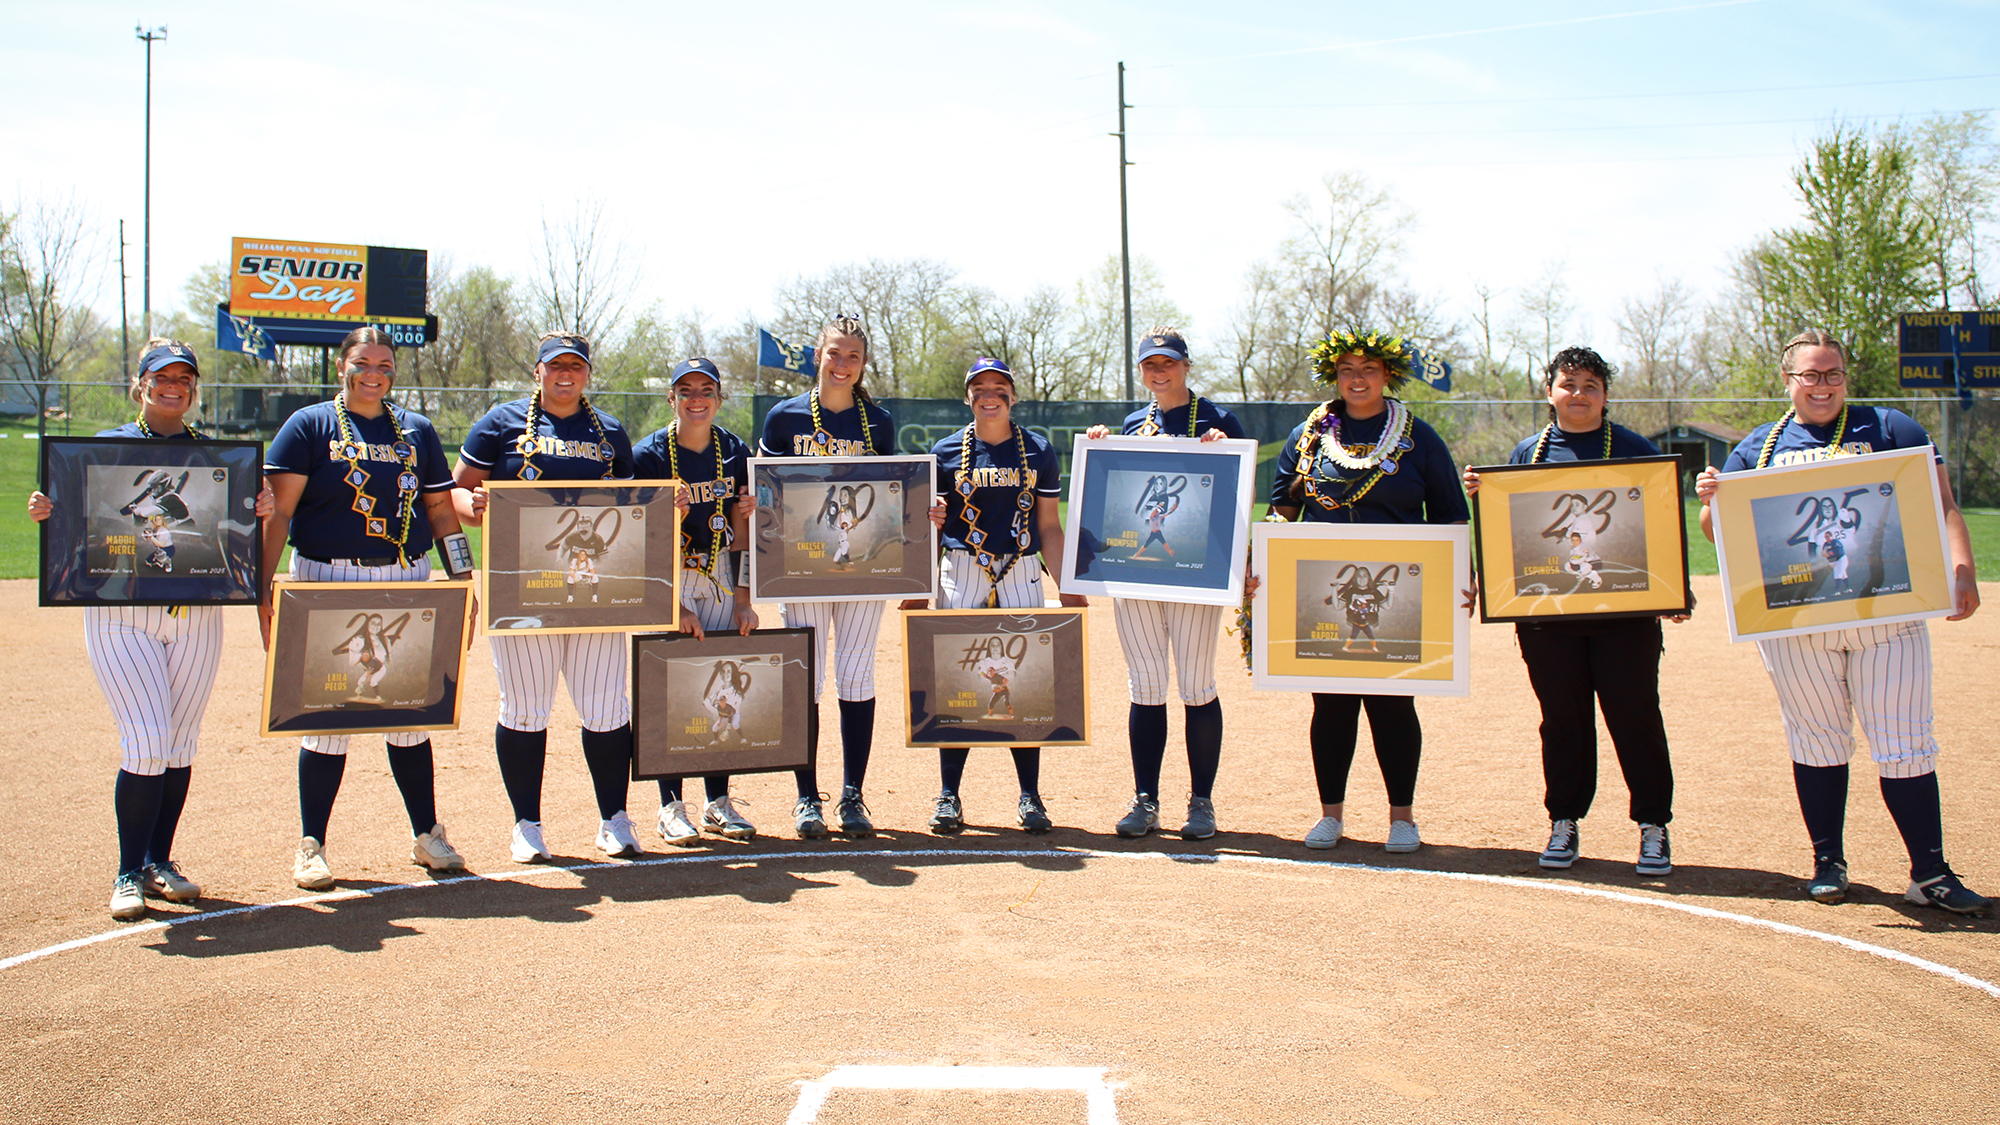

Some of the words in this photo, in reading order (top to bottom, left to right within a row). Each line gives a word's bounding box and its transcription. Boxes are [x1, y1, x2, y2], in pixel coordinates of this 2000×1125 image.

[243, 242, 284, 252] WILLIAM
[285, 245, 312, 253] PENN
[313, 246, 359, 256] SOFTBALL
[238, 254, 366, 283] SENIOR
[249, 270, 356, 314] Day
[1904, 313, 1964, 326] VISITOR
[1959, 330, 1971, 343] H
[1902, 366, 1942, 379] BALL
[797, 542, 826, 550] CHELSEY
[1106, 537, 1138, 548] THOMPSON
[108, 545, 136, 555] PIERCE
[809, 550, 826, 559] HUFF
[1547, 556, 1559, 565] LIZ
[1523, 565, 1560, 576] ESPINOSA
[1788, 562, 1812, 574] EMILY
[1781, 572, 1814, 585] BRYANT
[526, 579, 564, 589] ANDERSON
[1316, 622, 1339, 631] JENNA
[1311, 631, 1339, 640] RAPOZA
[327, 673, 348, 682] LAILA
[324, 682, 347, 691] PELOS
[958, 691, 977, 700] EMILY
[947, 699, 978, 708] WINKLER
[692, 717, 708, 726] ELLA
[685, 725, 708, 735] PIERCE
